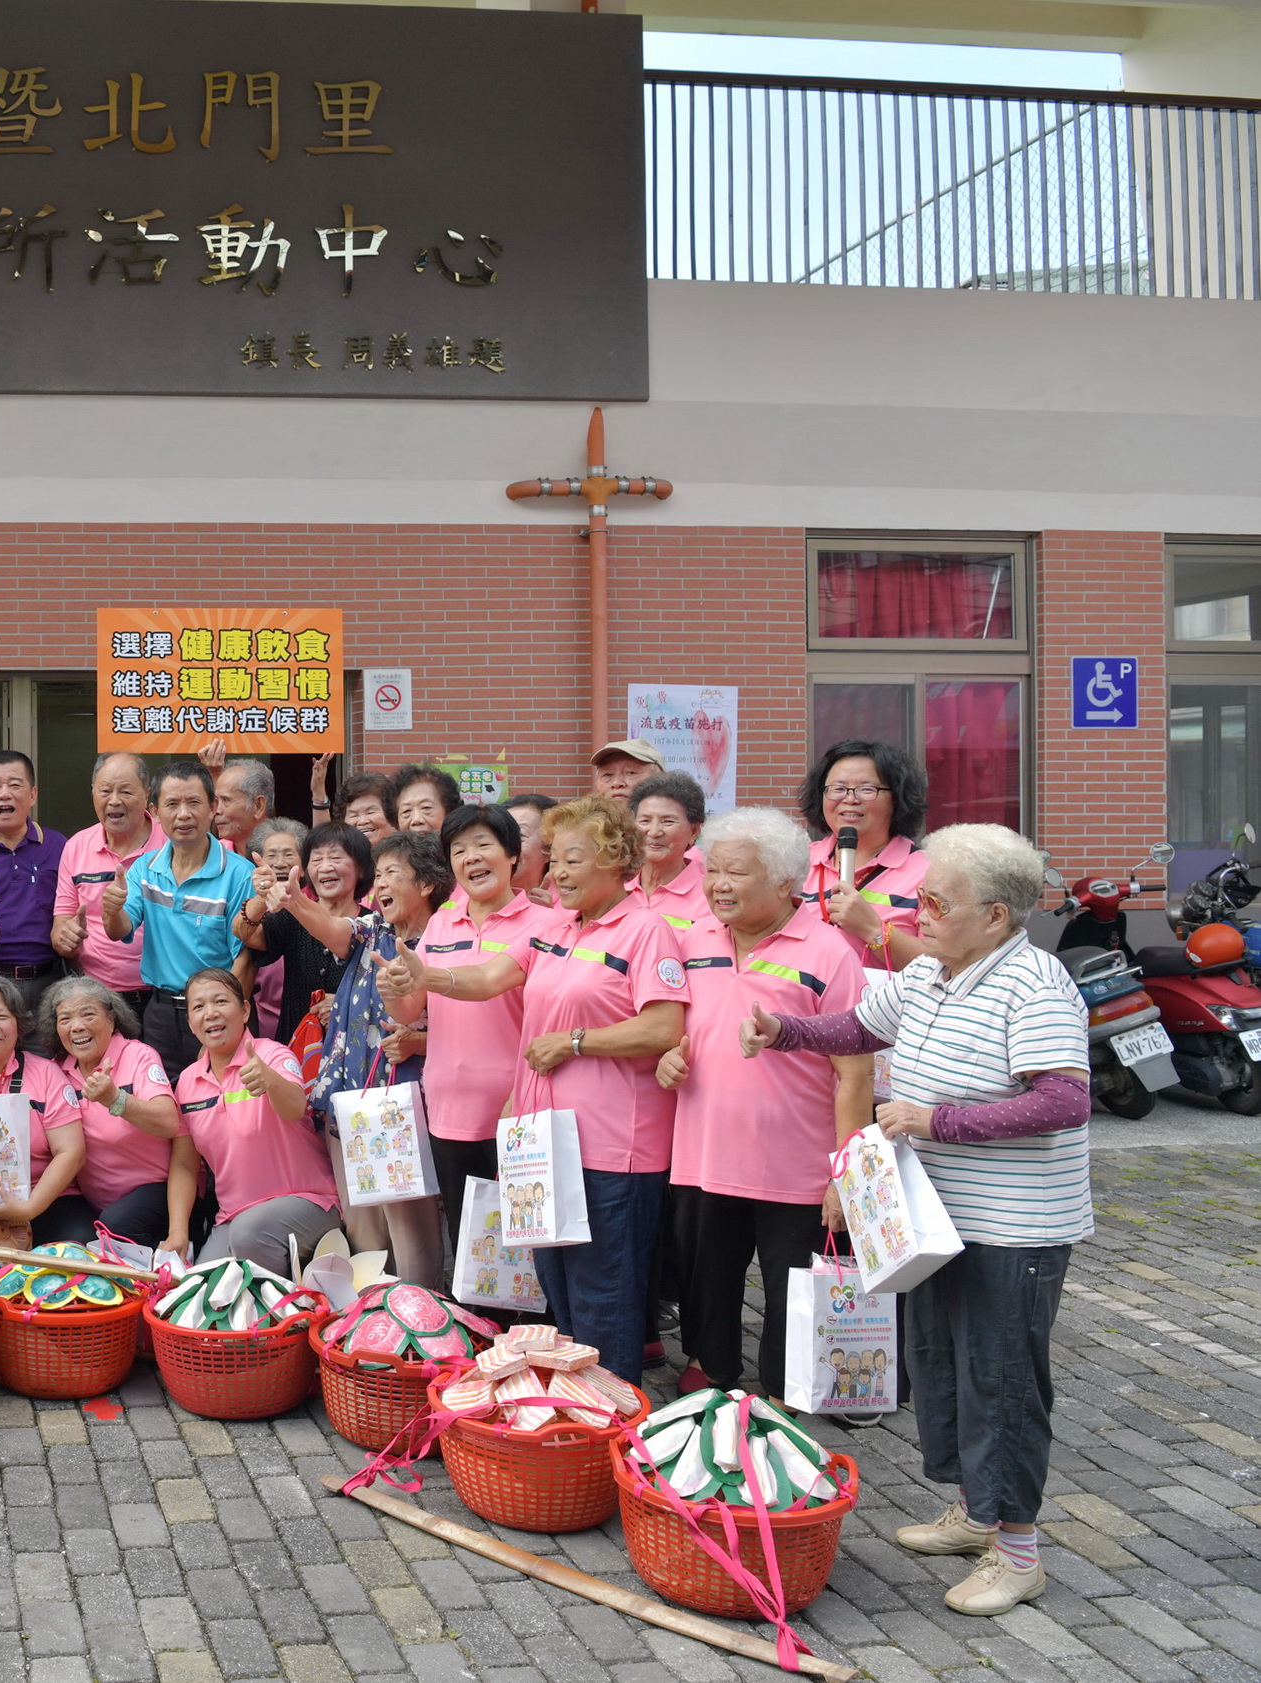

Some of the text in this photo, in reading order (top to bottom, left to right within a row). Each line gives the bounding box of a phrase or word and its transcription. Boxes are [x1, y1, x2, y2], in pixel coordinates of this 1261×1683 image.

[240, 331, 323, 370] 鎮長
[112, 628, 330, 661] 選擇健康飲食
[112, 667, 330, 700] 維持運動習慣
[1120, 663, 1132, 679] P
[113, 706, 329, 733] 遠離代謝症候群
[640, 716, 723, 730] 流感疫苗施打
